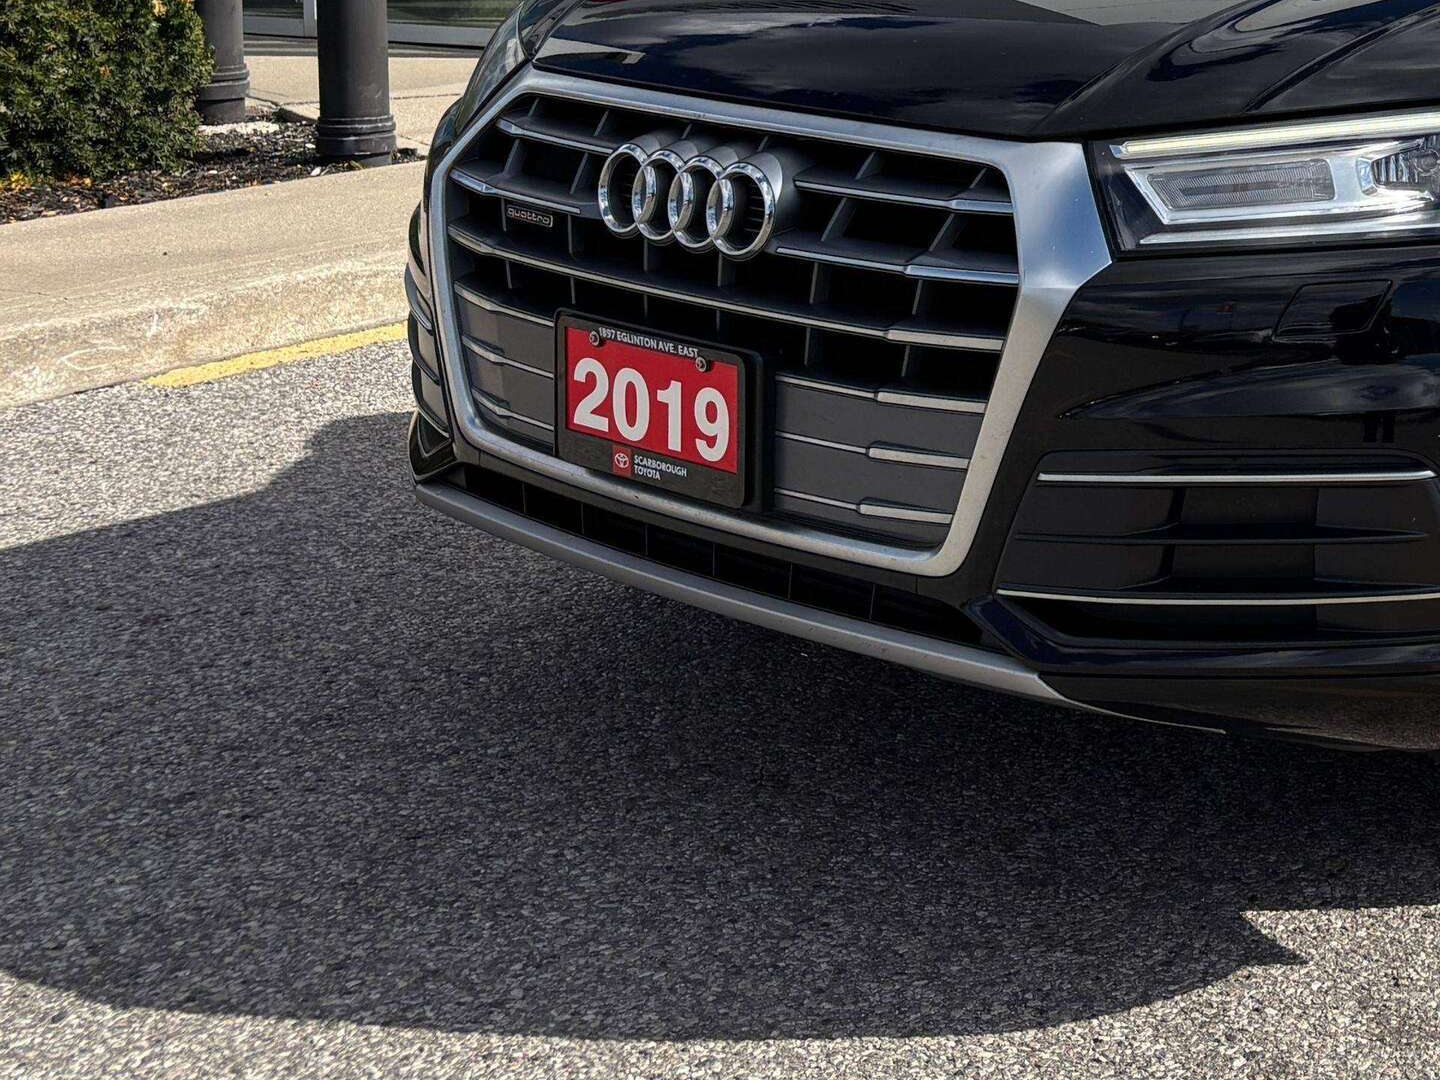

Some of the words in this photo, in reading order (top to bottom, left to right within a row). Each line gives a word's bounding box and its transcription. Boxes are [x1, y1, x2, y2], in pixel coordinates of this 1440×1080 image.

[507, 207, 550, 224] quattro
[599, 327, 615, 340] 1897
[616, 330, 657, 350] EGLINTON
[677, 344, 699, 358] EAST
[573, 357, 730, 462] 2019
[634, 455, 688, 477] SCARBOROUGH
[634, 465, 661, 480] TOYOTA
